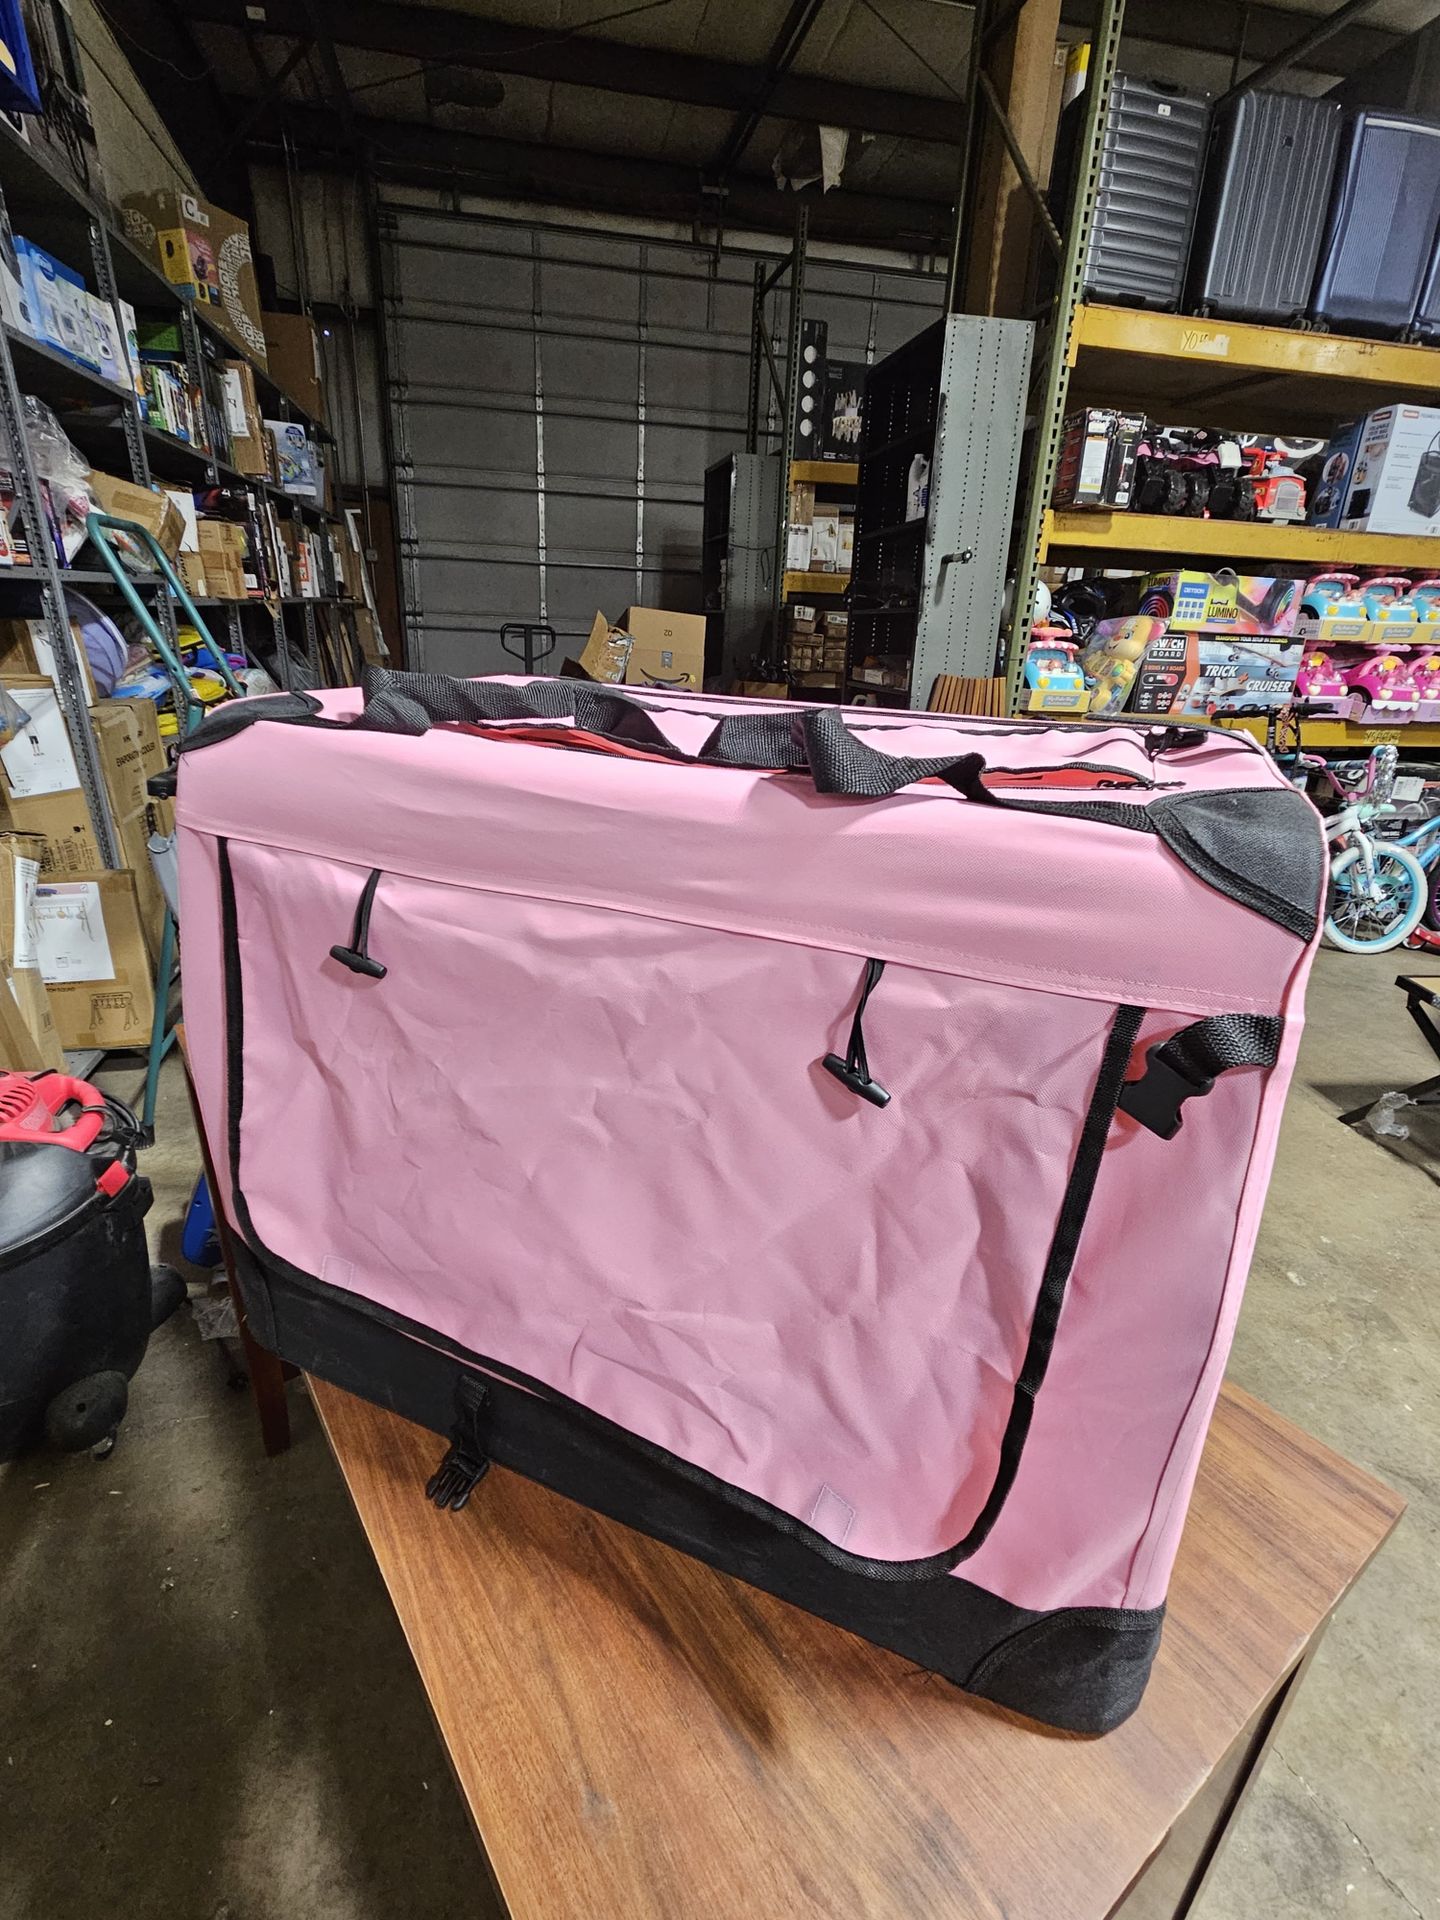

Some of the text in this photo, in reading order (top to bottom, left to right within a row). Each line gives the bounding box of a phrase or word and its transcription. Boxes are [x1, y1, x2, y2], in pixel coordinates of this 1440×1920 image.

[186, 199, 196, 217] C
[1207, 606, 1239, 619] LUMINO
[1205, 664, 1239, 677] TRICK
[1246, 680, 1292, 692] CRUISER
